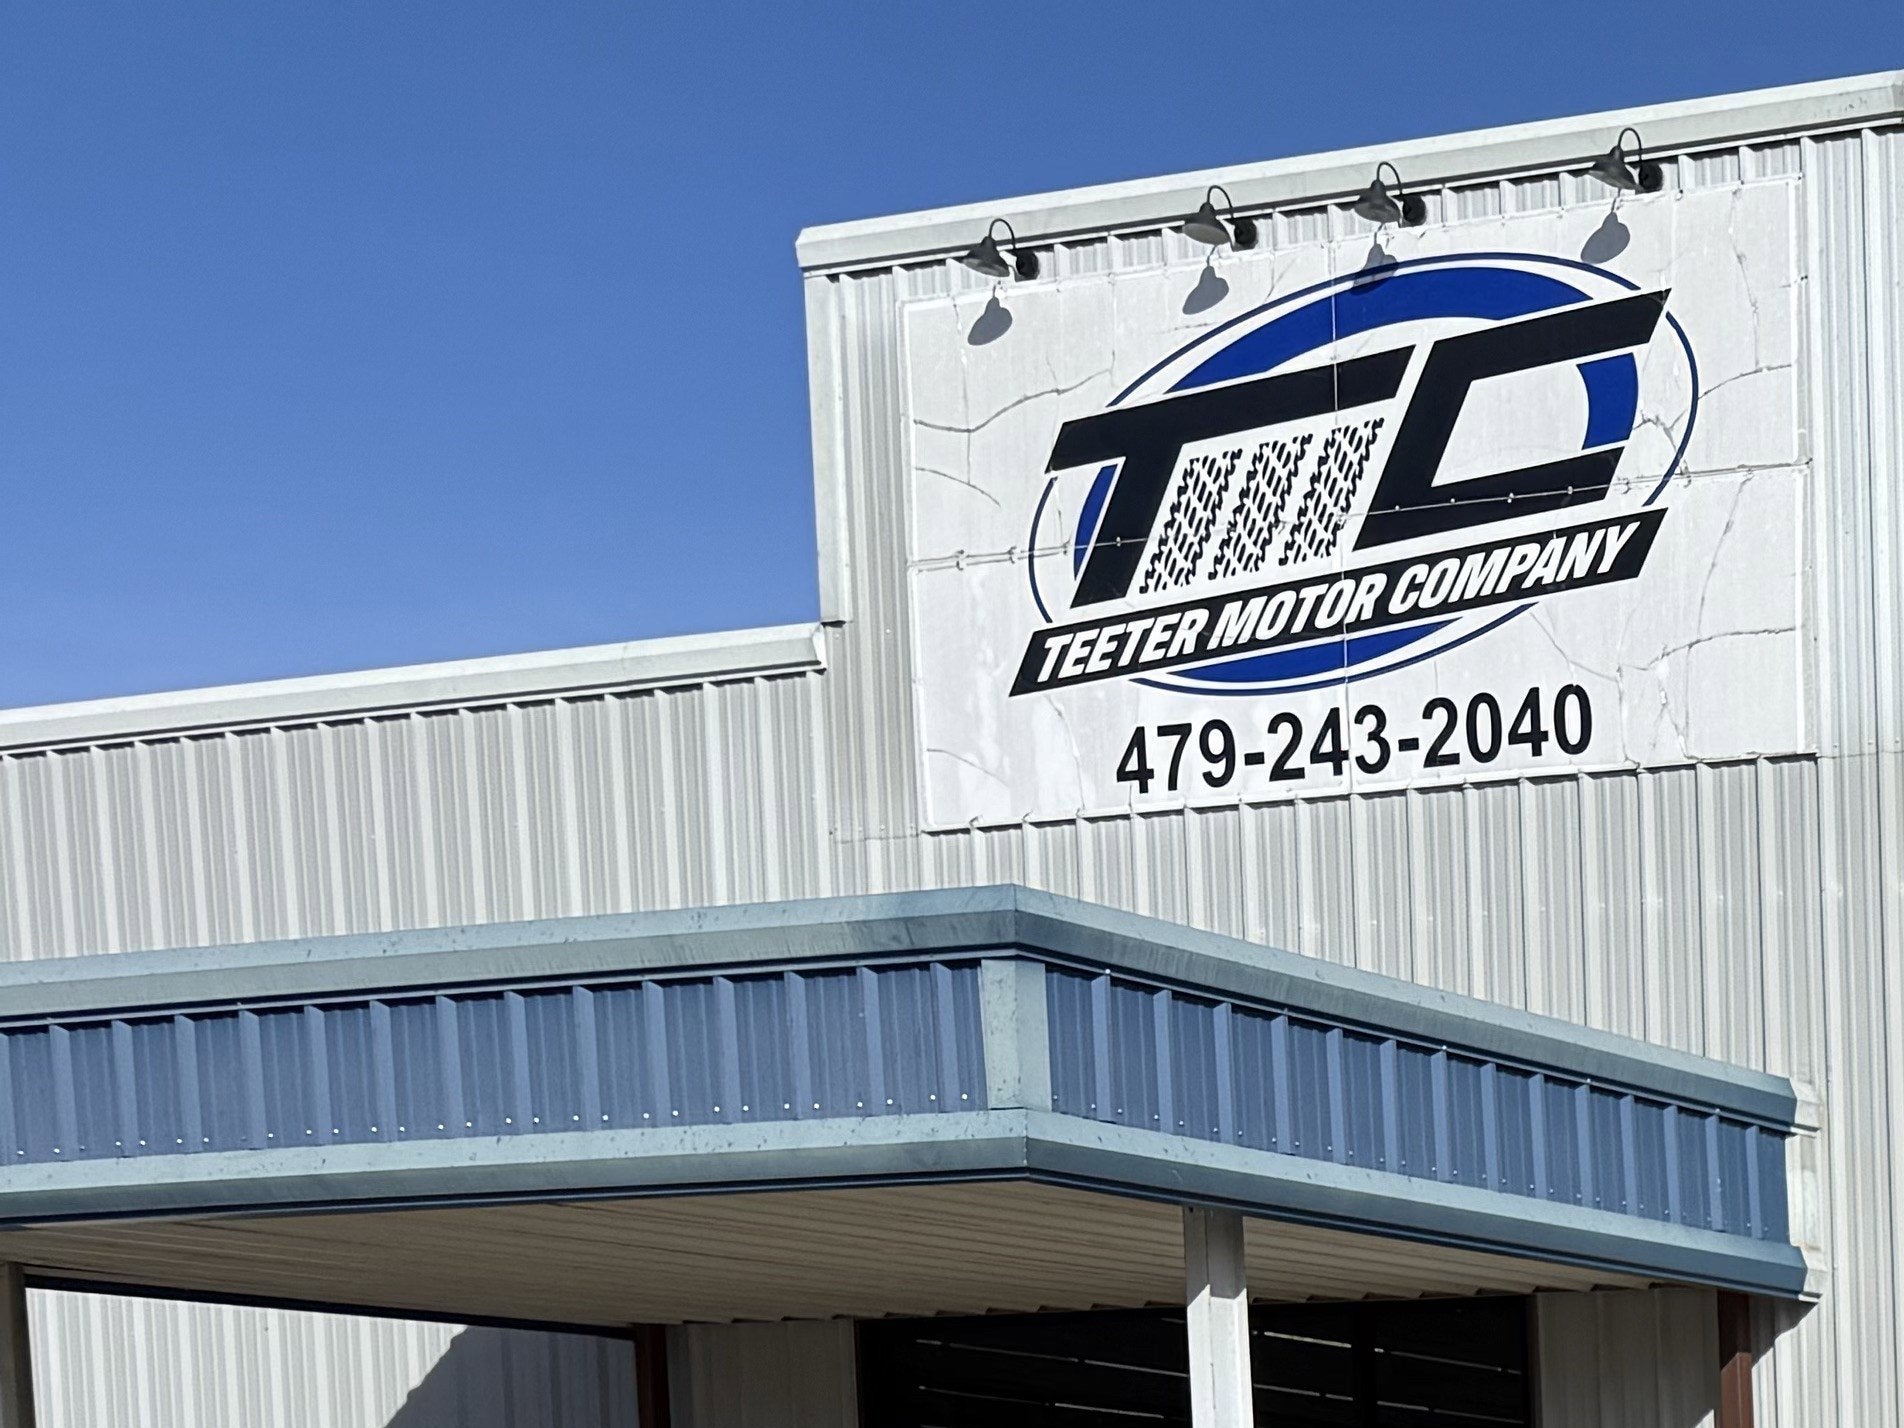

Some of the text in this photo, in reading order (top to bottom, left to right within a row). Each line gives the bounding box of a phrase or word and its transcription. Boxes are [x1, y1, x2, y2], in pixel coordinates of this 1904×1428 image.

[1036, 521, 1642, 684] TEETER MOTOR COMPANY
[1116, 683, 1593, 794] 479-243-2040
